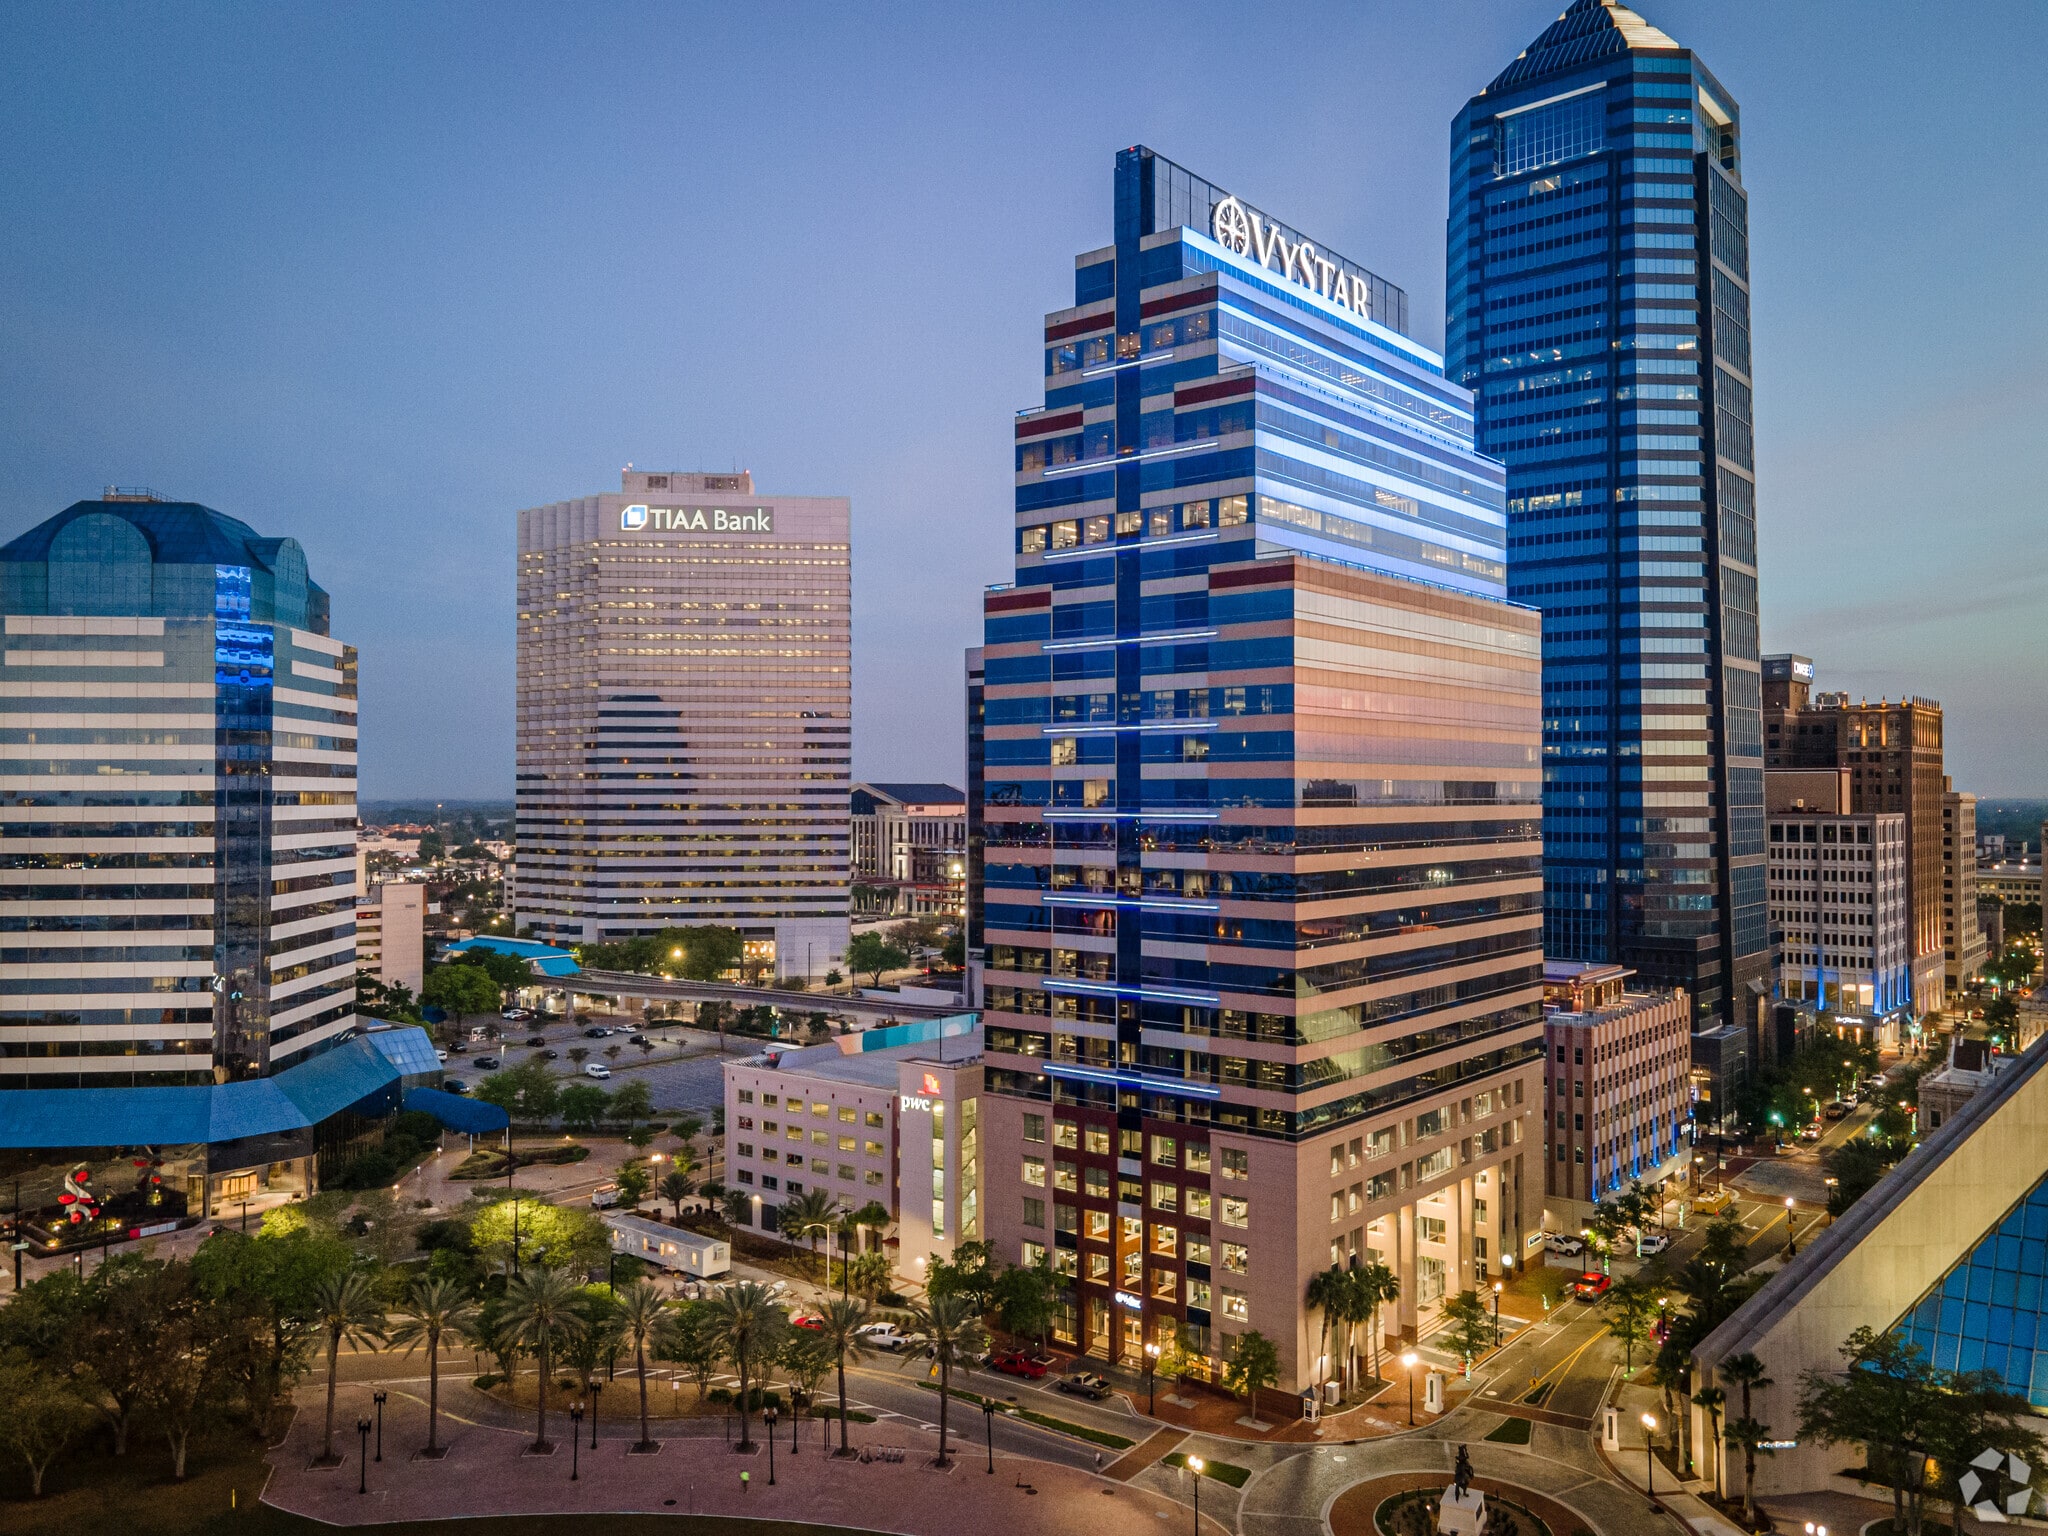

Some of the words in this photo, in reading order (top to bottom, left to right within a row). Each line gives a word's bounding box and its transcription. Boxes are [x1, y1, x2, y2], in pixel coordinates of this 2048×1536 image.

[650, 509, 708, 530] TIAA
[714, 508, 770, 531] Bank
[900, 1095, 930, 1112] pwc
